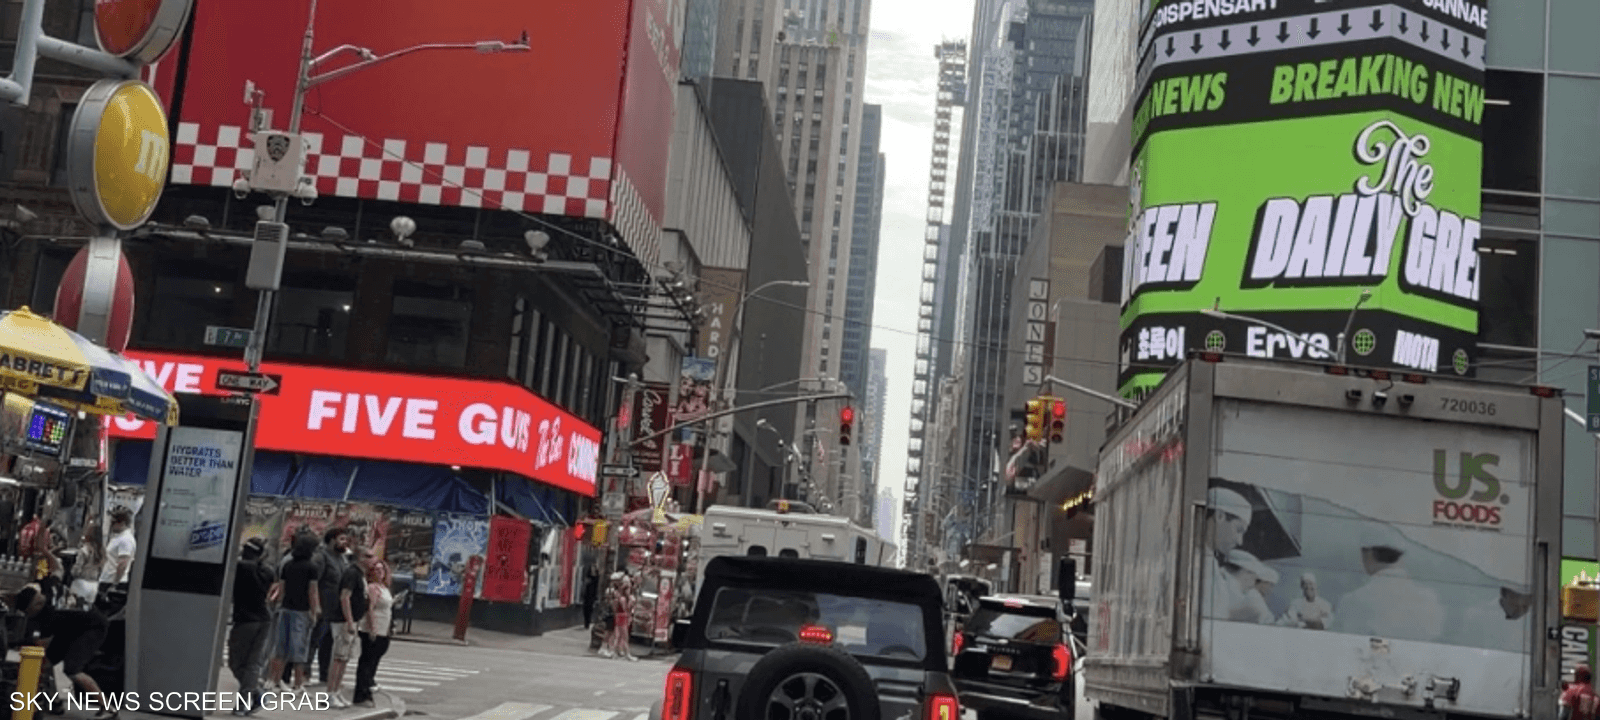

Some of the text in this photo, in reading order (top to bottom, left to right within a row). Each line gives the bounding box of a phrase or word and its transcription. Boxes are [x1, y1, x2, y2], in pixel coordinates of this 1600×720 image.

[1150, 72, 1227, 119] NEWS
[1269, 53, 1428, 104] BREAKING
[1433, 71, 1485, 124] NEW
[134, 130, 166, 183] m
[1354, 119, 1434, 217] The
[1246, 193, 1402, 281] DAILY
[1404, 203, 1481, 302] GRE
[707, 302, 723, 357] HARD
[1027, 283, 1046, 382] JONES
[1247, 326, 1330, 358] Erva
[222, 374, 268, 388] ONE WAY
[307, 389, 439, 440] FIVE
[1440, 397, 1496, 416] 720036
[168, 466, 202, 477] WATER
[170, 456, 234, 469] BETTER THAN
[172, 444, 222, 458] HYDRATES
[1433, 500, 1502, 525] FOODS
